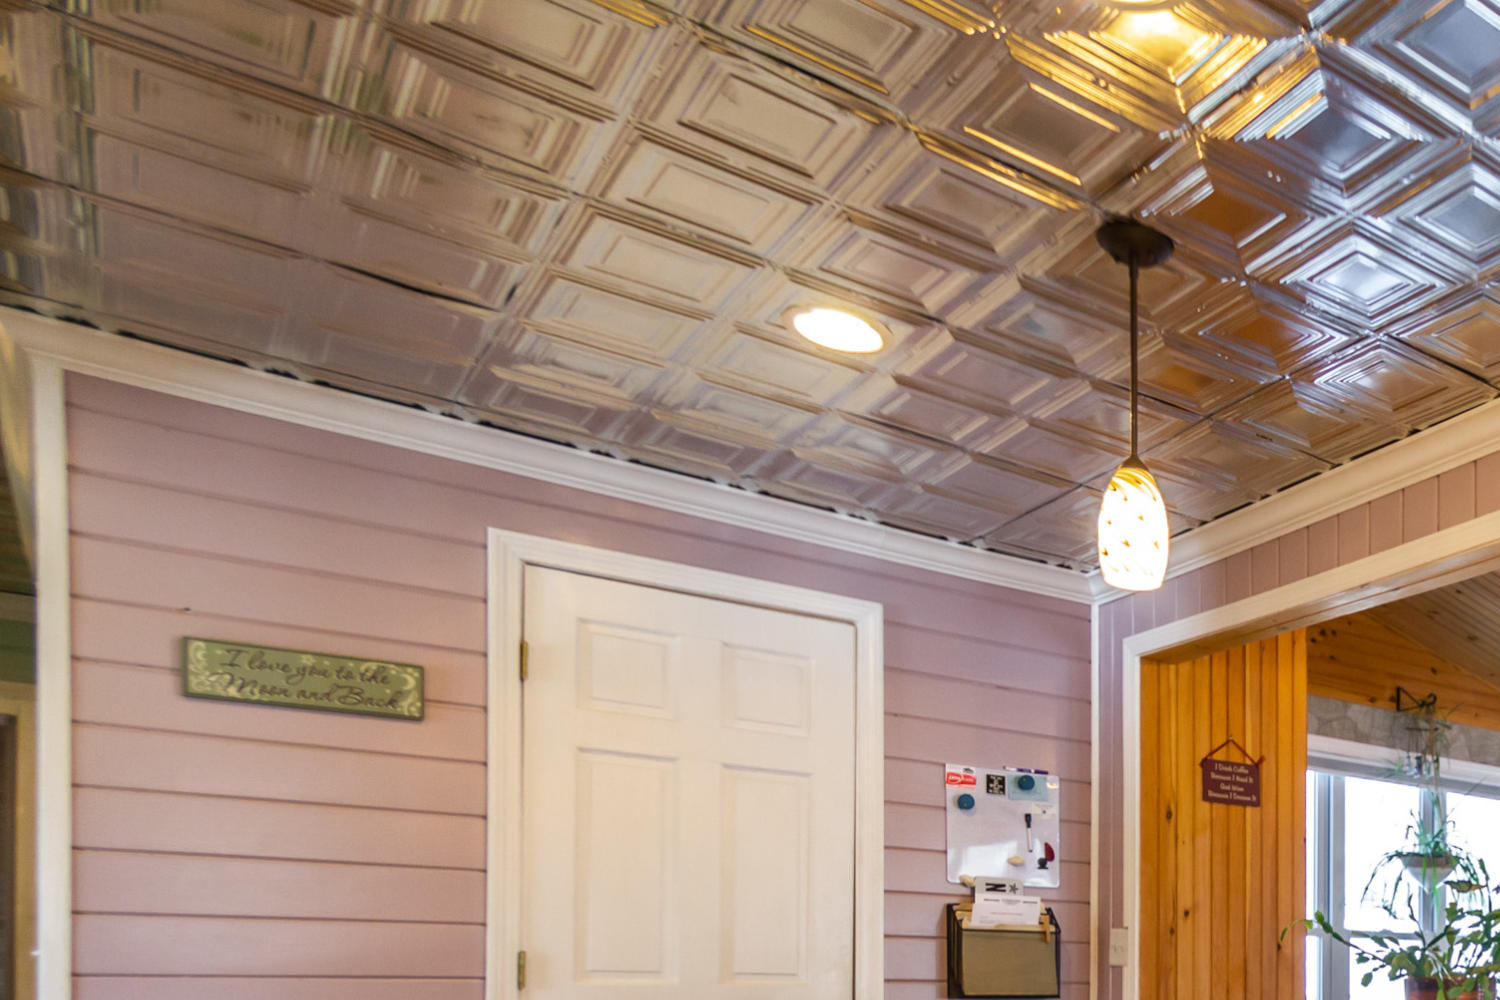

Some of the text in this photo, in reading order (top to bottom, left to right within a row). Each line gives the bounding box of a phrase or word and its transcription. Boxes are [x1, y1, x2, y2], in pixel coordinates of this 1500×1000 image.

[220, 650, 391, 685] I love you to the
[208, 672, 404, 709] Moon and Back
